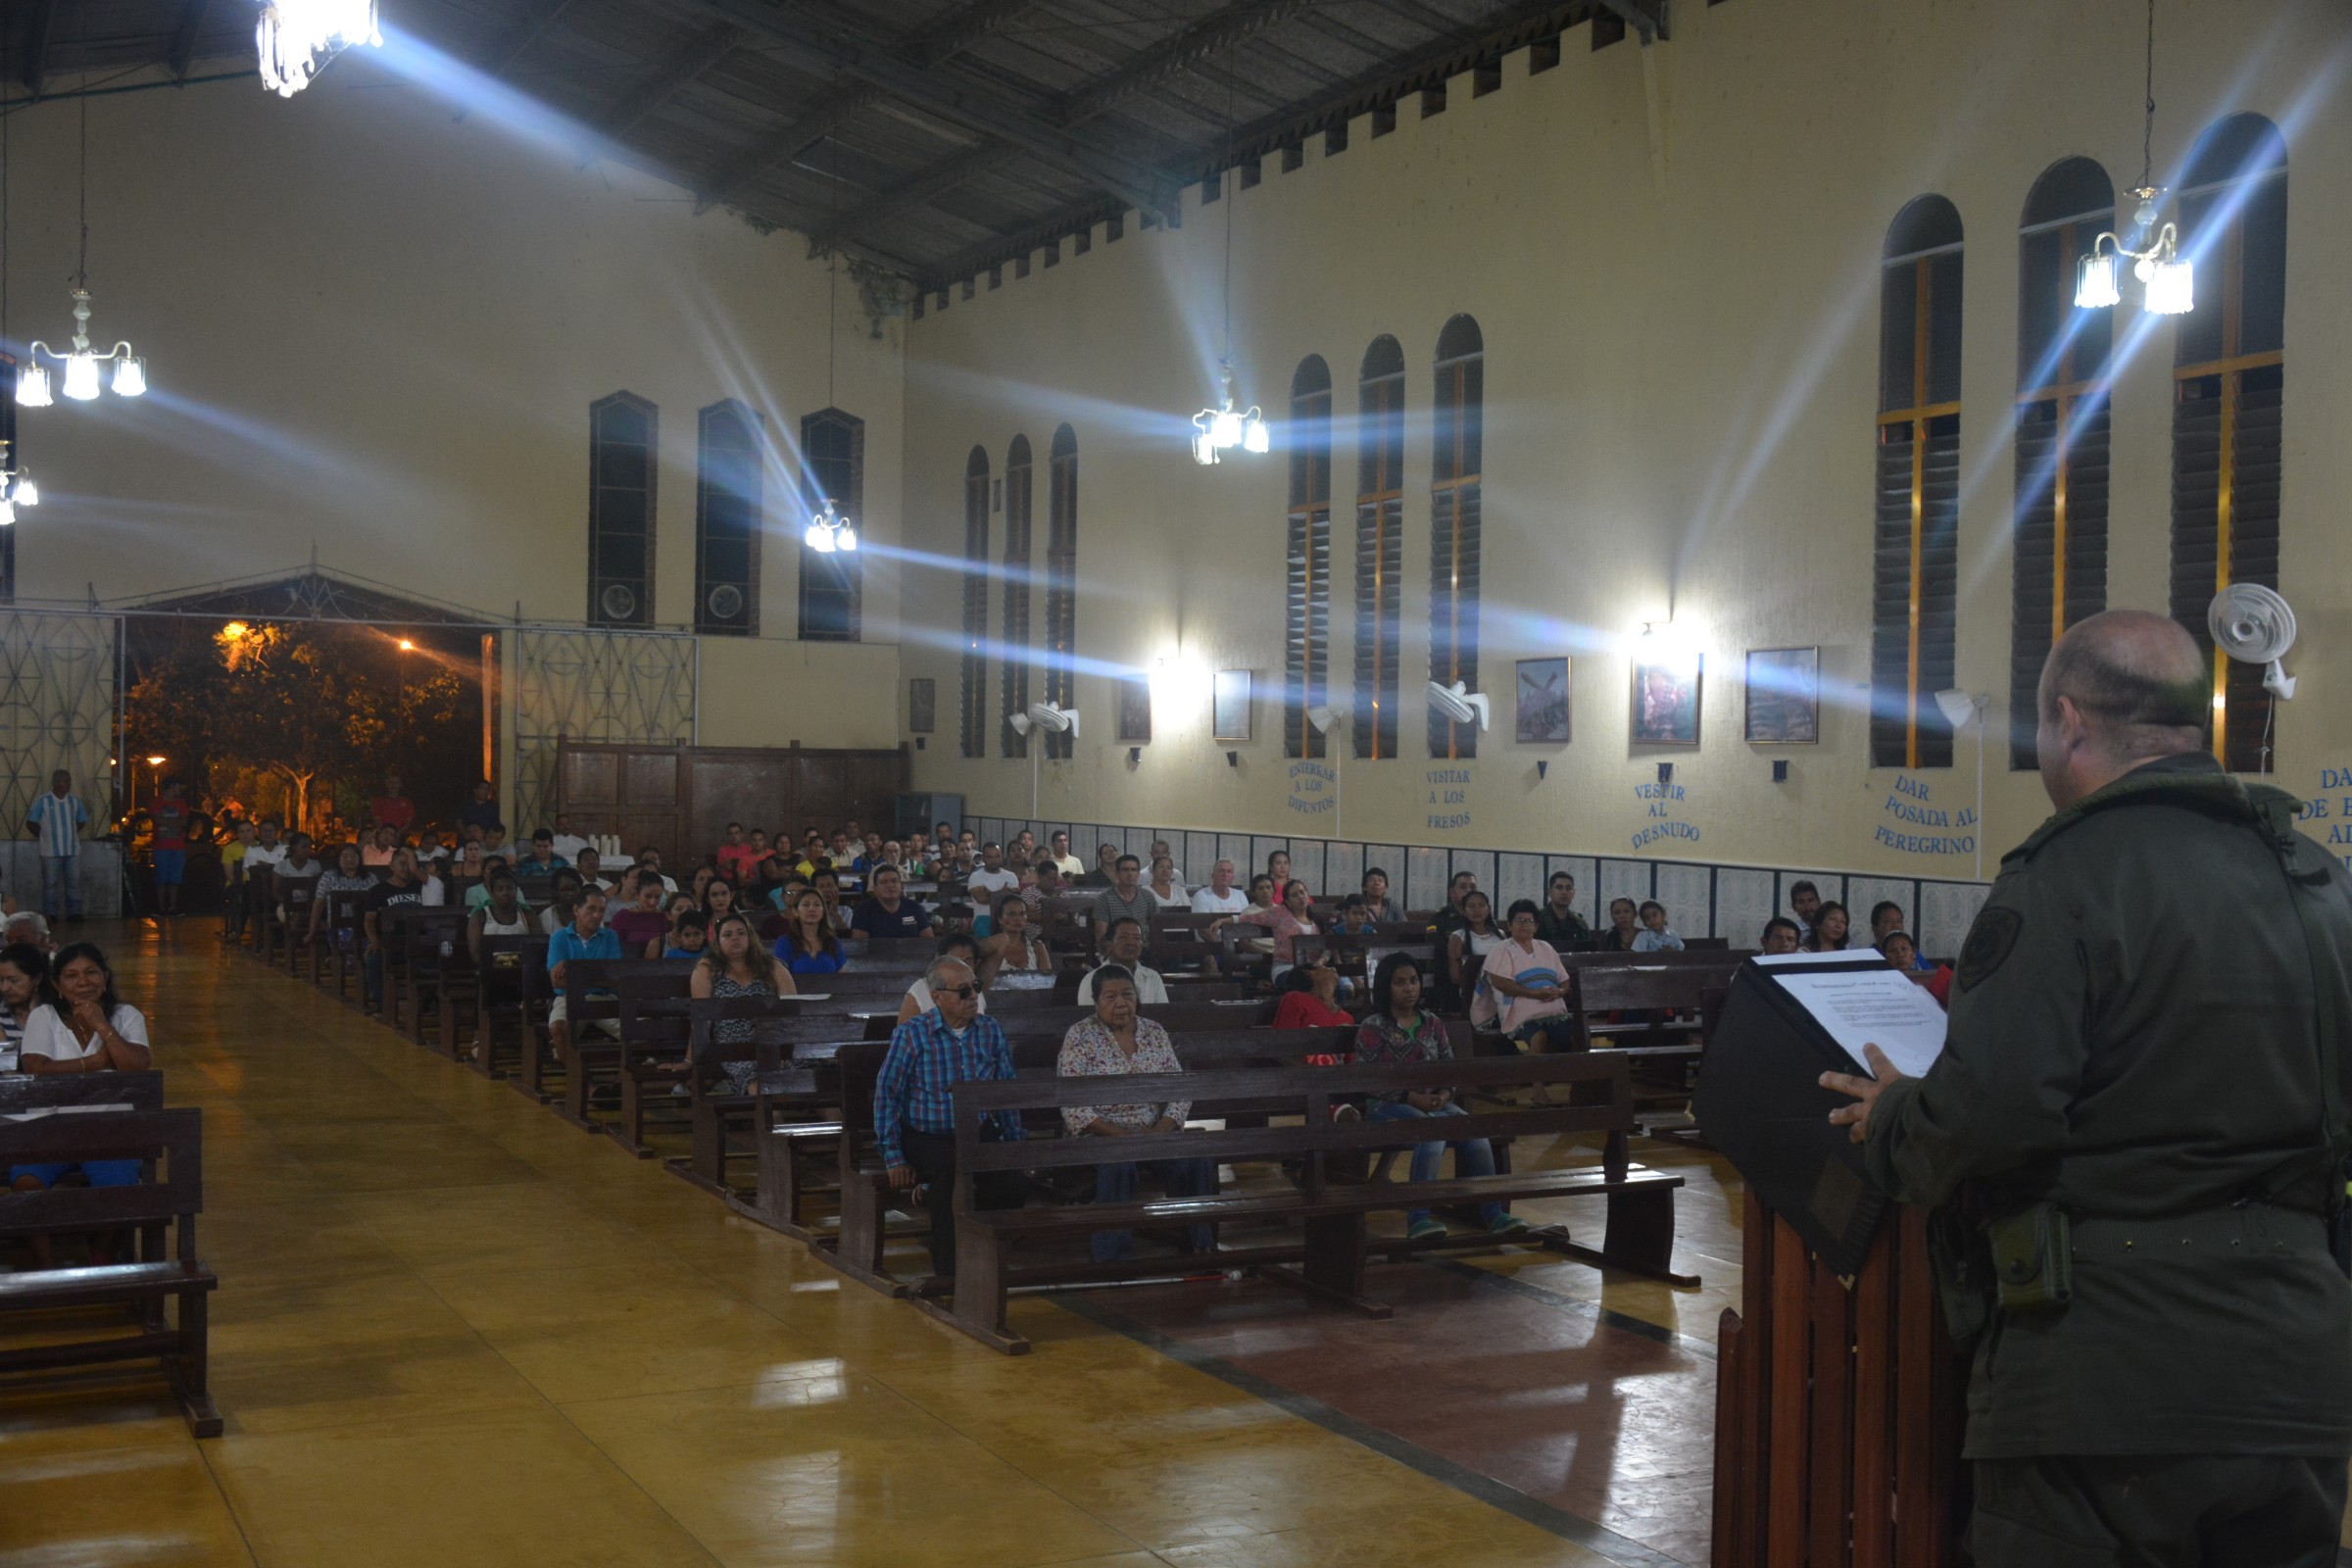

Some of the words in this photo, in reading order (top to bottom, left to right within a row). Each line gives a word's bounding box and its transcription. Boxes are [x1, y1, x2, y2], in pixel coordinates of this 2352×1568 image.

[1289, 761, 1335, 783] ENTERRAR
[1426, 769, 1471, 784] VISITAR
[1295, 780, 1301, 792] A
[1305, 779, 1322, 792] LOS
[1634, 783, 1686, 801] VESTIR
[1894, 774, 1930, 802] DAR
[1288, 795, 1334, 814] DIFUNTOS
[1429, 791, 1437, 804] A
[1444, 790, 1464, 804] LOS
[1648, 802, 1667, 817] AL
[1885, 794, 1949, 828] POSADA
[1955, 807, 1979, 828] AL
[2297, 799, 2328, 820] DE
[1632, 822, 1700, 850] DESNUDO
[1875, 825, 1975, 856] PEREGRINO
